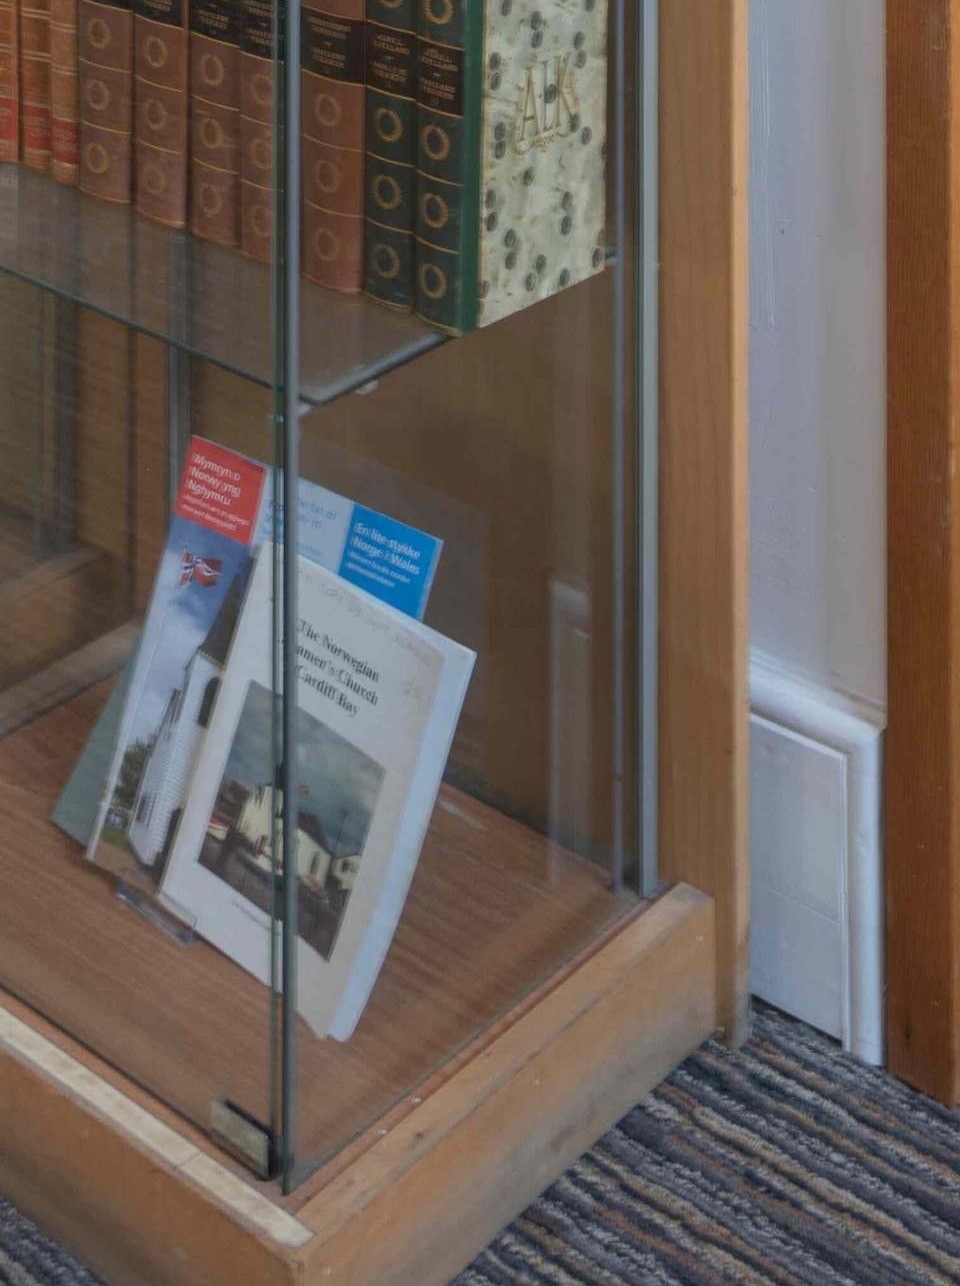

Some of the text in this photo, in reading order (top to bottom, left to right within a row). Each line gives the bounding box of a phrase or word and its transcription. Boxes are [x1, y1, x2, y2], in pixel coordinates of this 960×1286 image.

[352, 535, 384, 558] Norge
[390, 553, 421, 575] Wales
[297, 618, 321, 643] The
[321, 633, 380, 683] Norwegian
[296, 664, 361, 717] Cardiff Bay
[335, 667, 379, 706] Church
